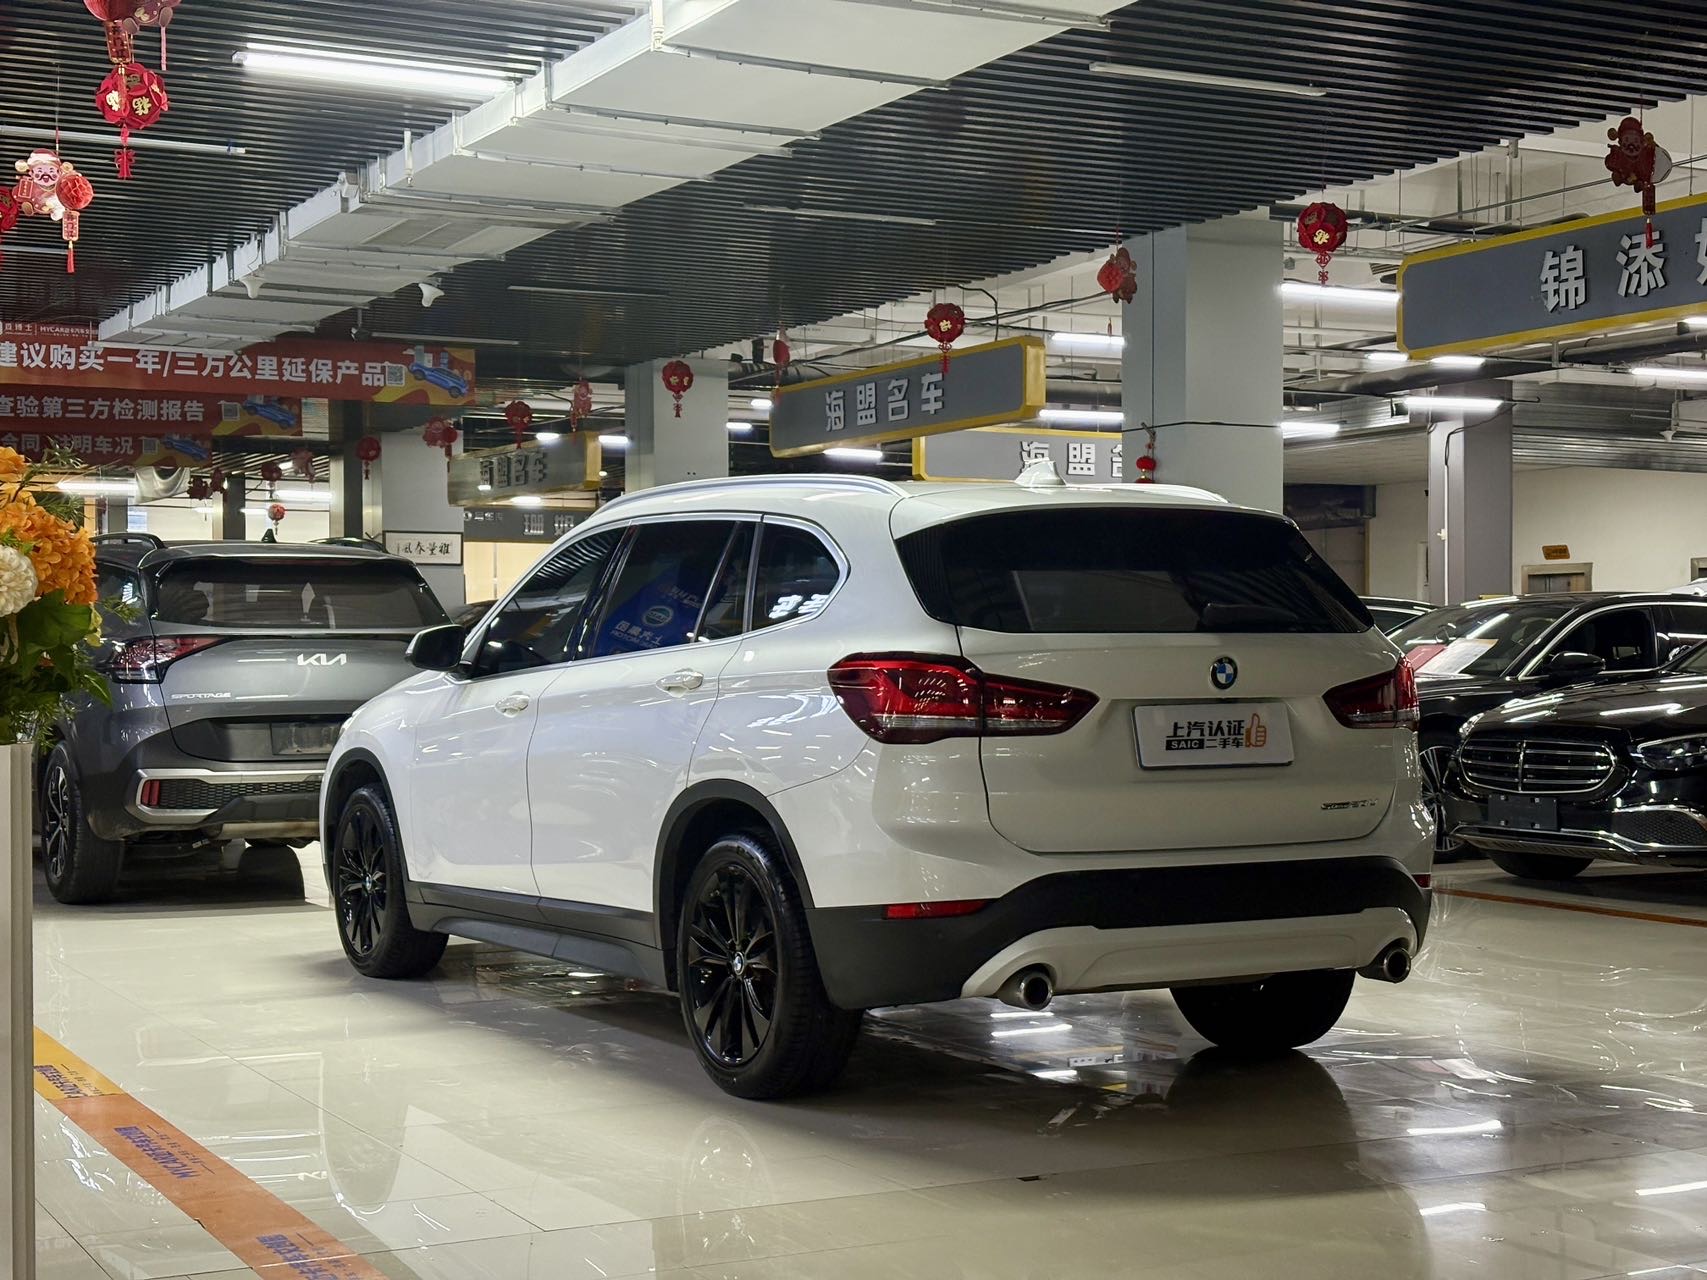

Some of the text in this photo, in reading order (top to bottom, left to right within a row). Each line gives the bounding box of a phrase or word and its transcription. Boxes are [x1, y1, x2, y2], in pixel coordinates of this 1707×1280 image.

[0, 394, 205, 422] 查验第三方检测报告
[825, 371, 945, 432] 海盟名车
[1166, 719, 1245, 738] 上汽认证
[1171, 737, 1244, 749] SAIC 二手车
